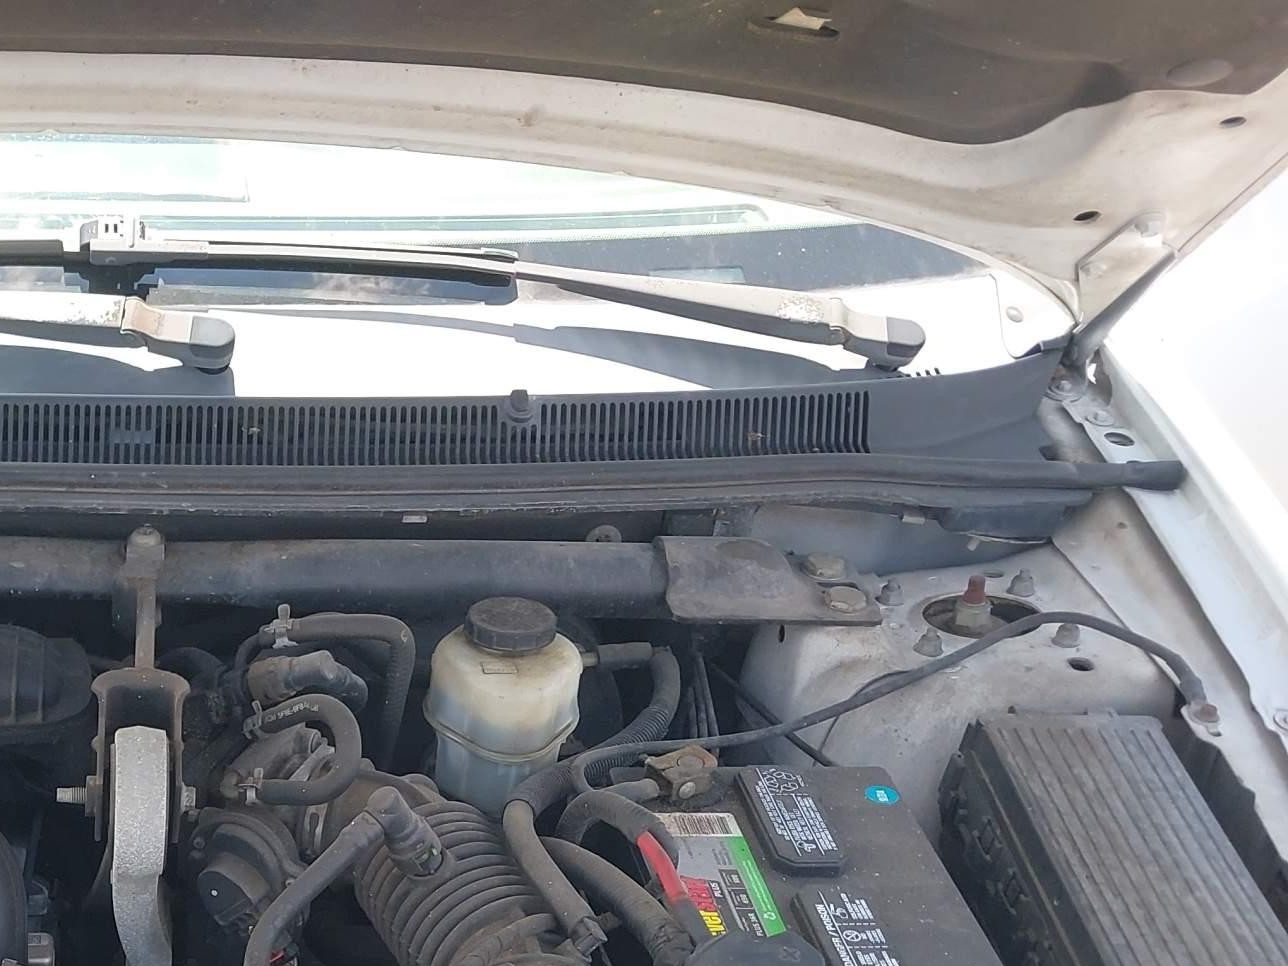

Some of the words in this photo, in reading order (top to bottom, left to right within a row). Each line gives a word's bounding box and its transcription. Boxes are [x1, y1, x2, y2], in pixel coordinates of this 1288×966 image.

[710, 881, 724, 898] PLUS
[815, 904, 836, 931] POISON
[832, 937, 854, 966] DANGER
